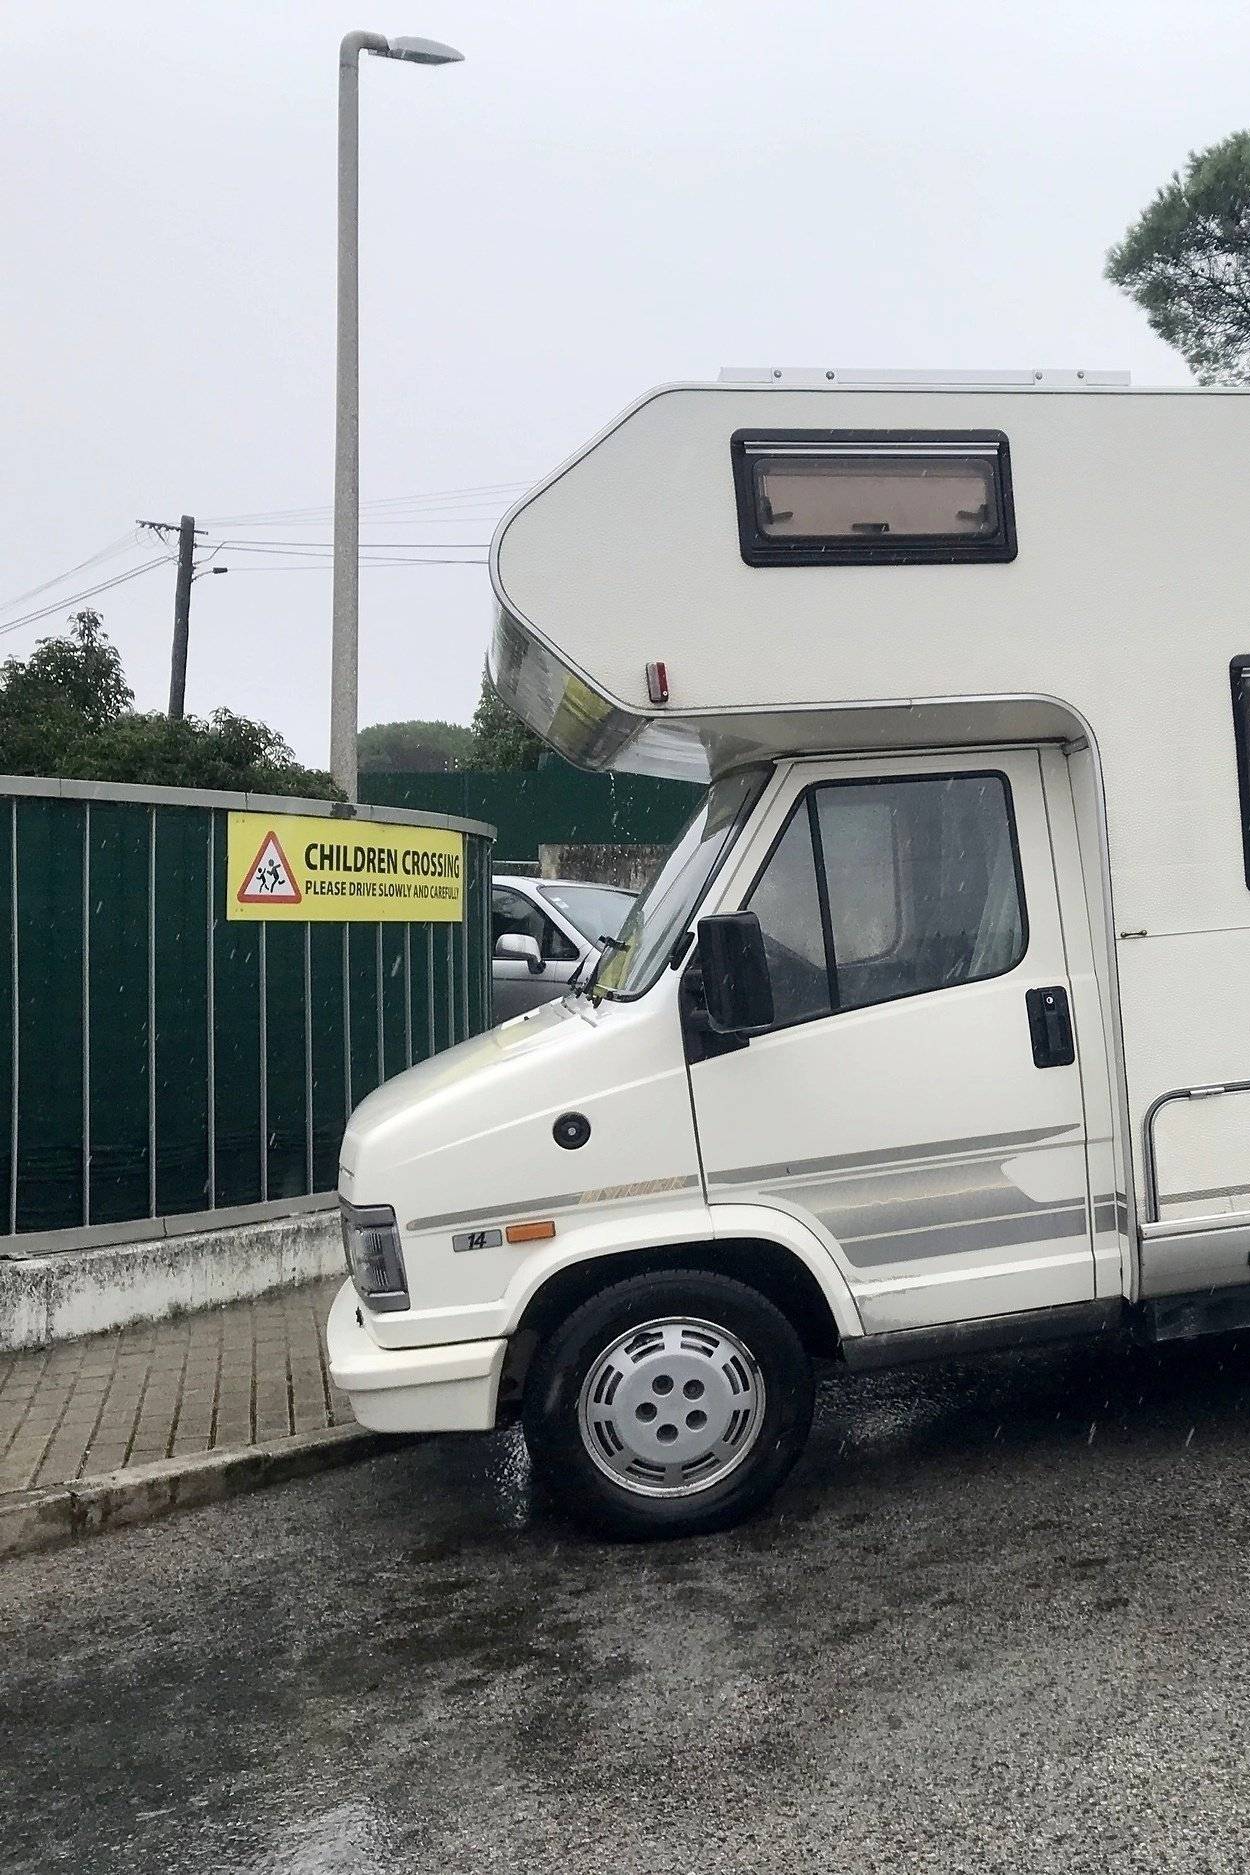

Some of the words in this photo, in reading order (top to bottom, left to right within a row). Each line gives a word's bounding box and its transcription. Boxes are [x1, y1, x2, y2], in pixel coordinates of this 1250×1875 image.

[304, 843, 397, 874] CHILDREN
[402, 850, 459, 878] CROSSING
[305, 880, 347, 896] PLEASE
[349, 882, 377, 897] DRIVE
[378, 883, 412, 898] SLOWLY
[413, 885, 429, 899] AND
[430, 885, 459, 900] CAREFULLY
[468, 1232, 487, 1249] 14
